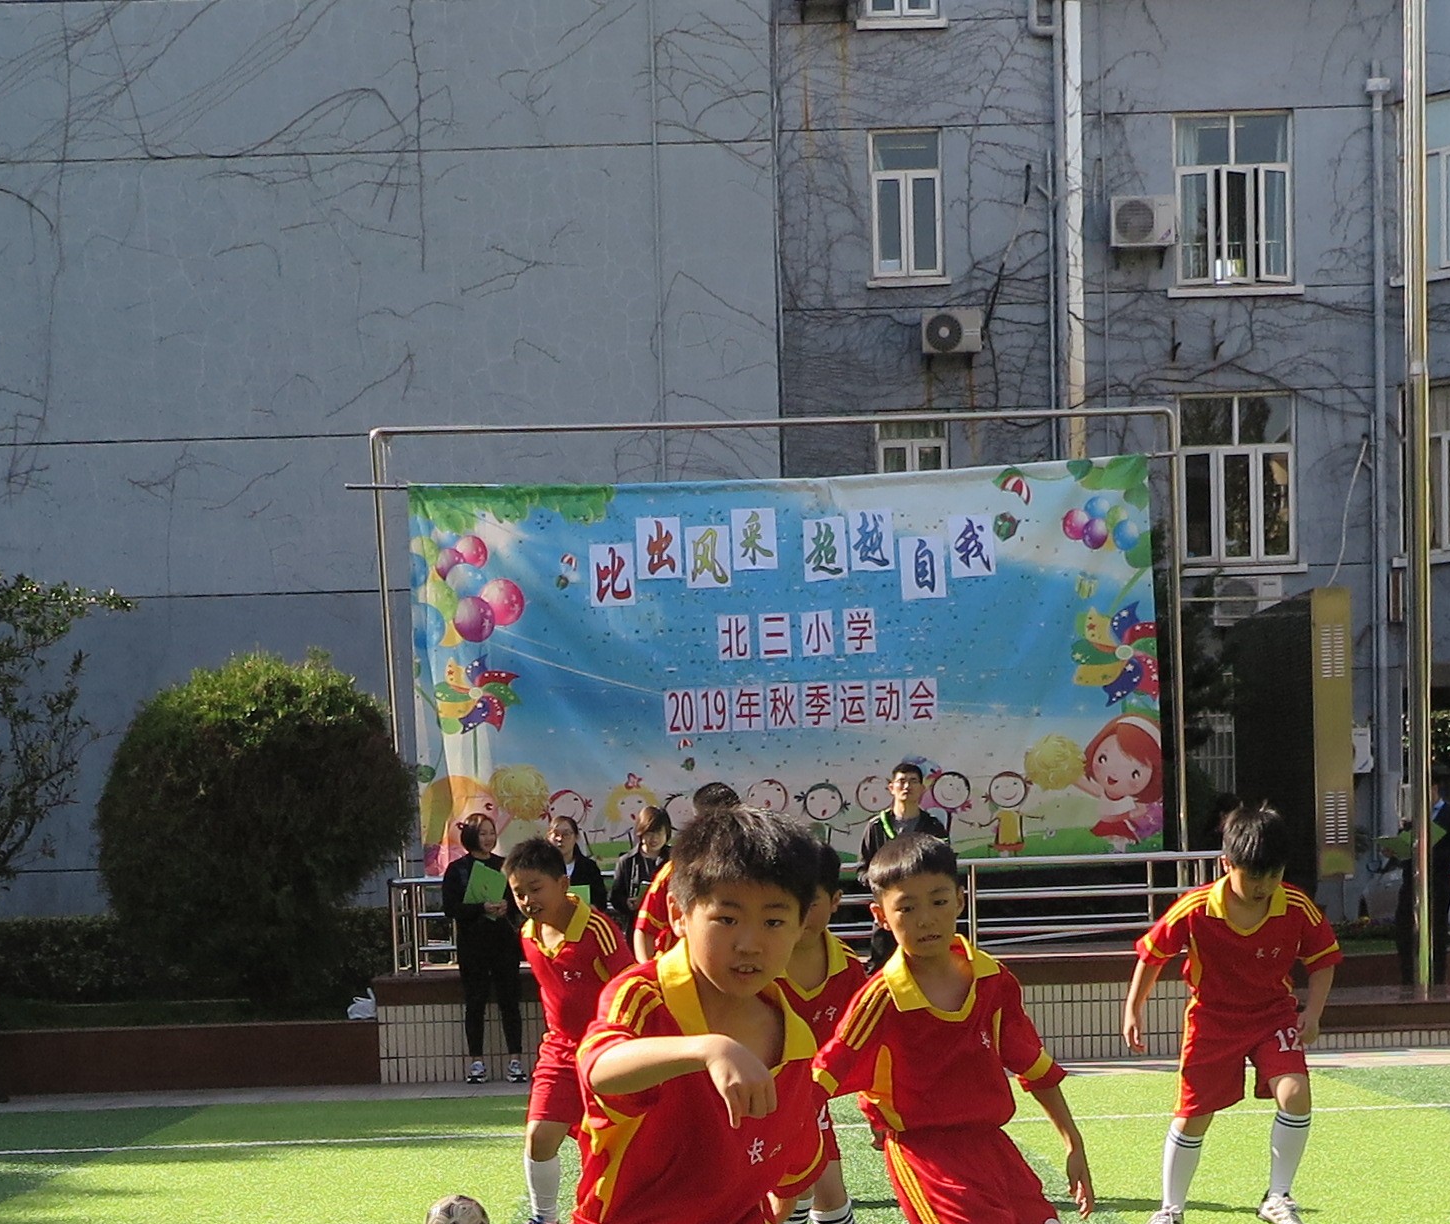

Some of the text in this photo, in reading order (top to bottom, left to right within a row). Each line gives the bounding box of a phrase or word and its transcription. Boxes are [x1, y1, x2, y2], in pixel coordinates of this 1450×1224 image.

[595, 510, 993, 604] 比出风采 超越自我
[721, 611, 873, 659] 北三小学
[667, 681, 935, 733] 2019年秋季运动会
[1275, 1027, 1302, 1052] 12
